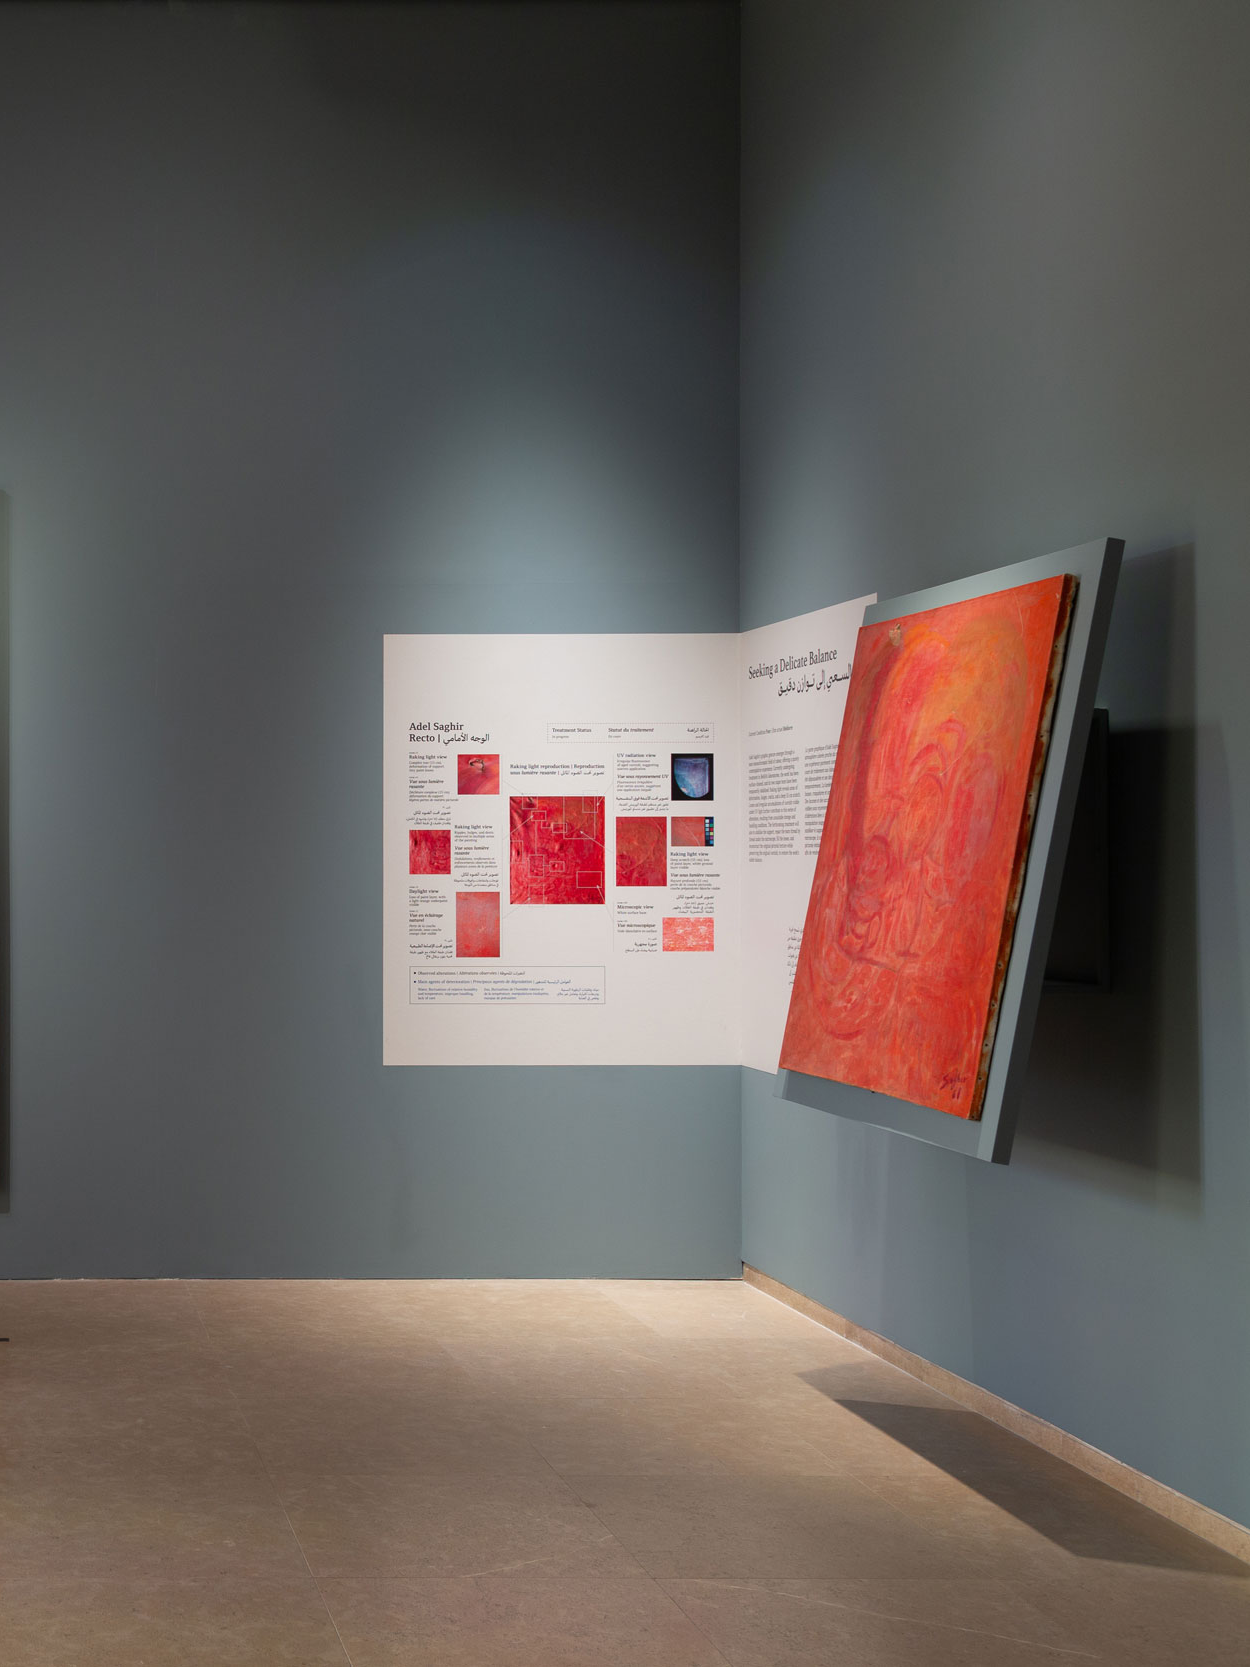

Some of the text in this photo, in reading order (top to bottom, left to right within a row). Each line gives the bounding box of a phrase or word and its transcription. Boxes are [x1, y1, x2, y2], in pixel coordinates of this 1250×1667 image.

[748, 648, 838, 680] Seeking a Delicate Balance
[409, 722, 464, 733] Adel Saghir
[409, 734, 435, 742] Recto
